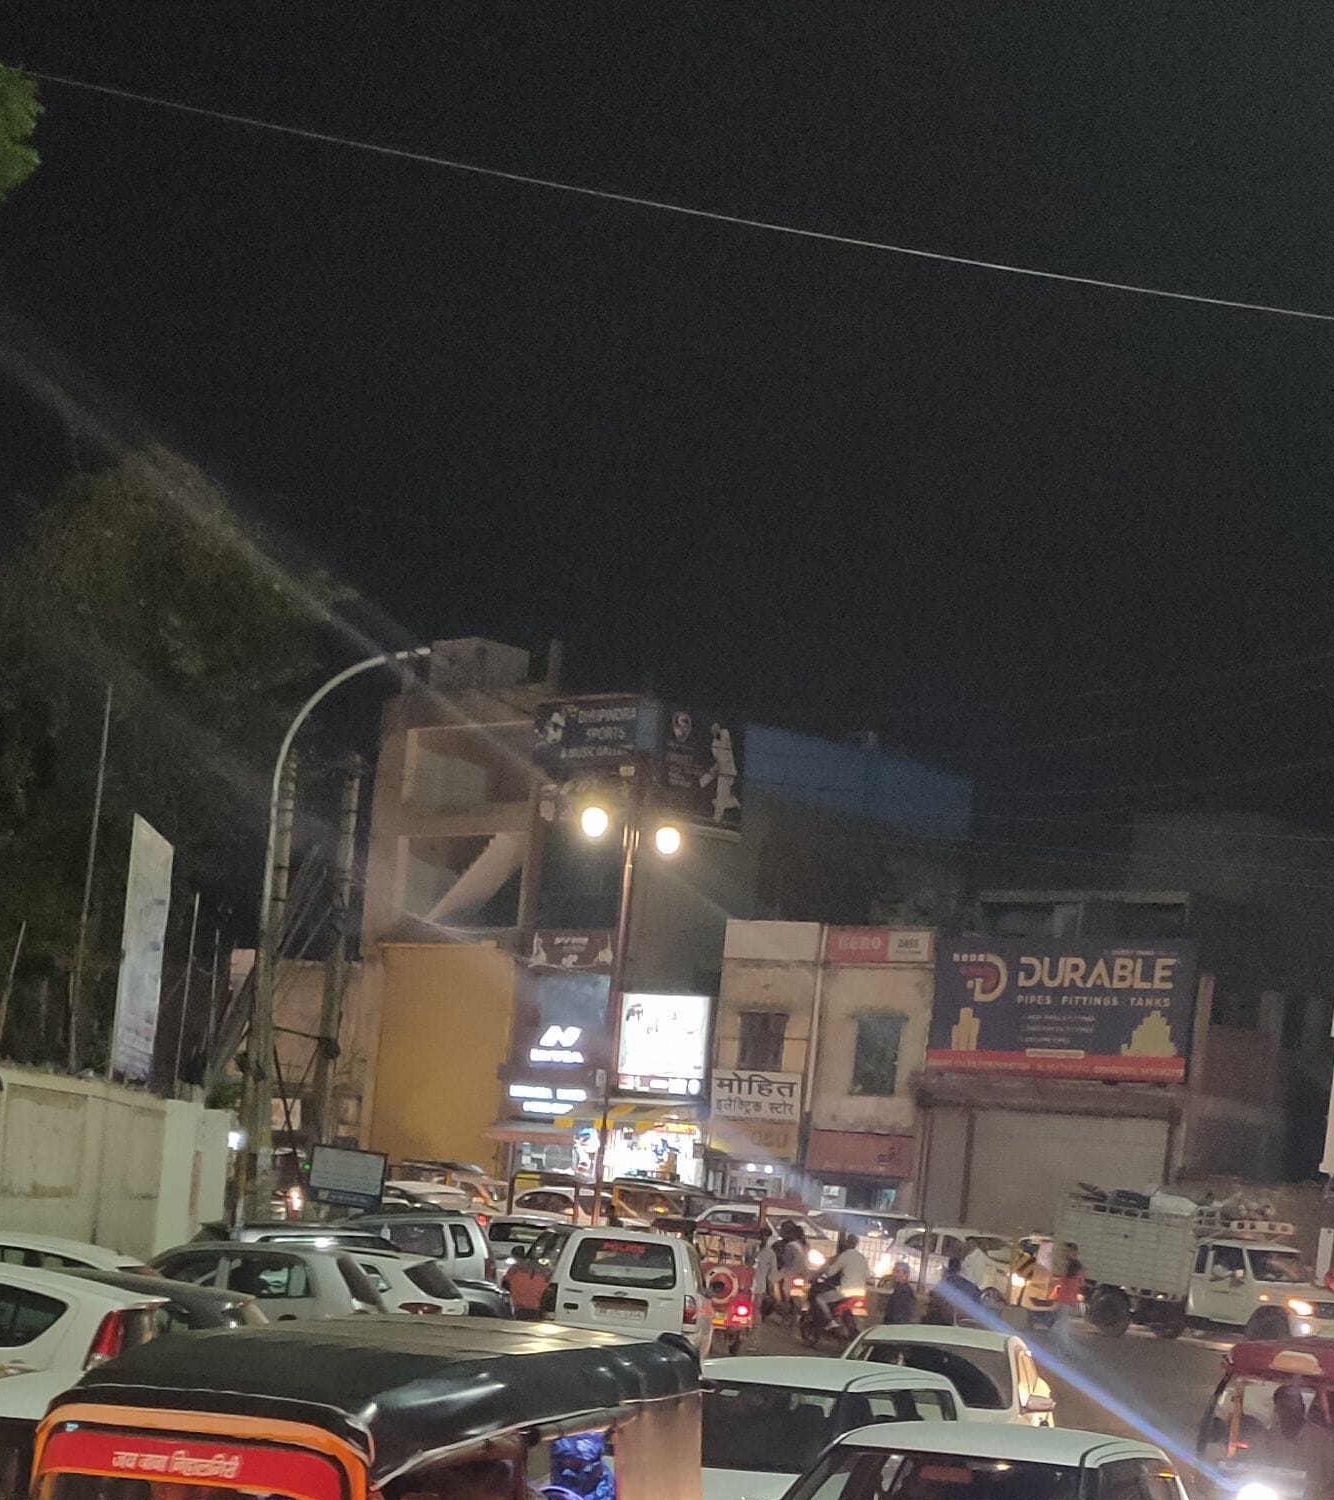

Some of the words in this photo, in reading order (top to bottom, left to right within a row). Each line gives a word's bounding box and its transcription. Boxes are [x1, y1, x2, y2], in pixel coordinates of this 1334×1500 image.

[1018, 955, 1177, 990] DURABLE
[1018, 994, 1052, 1006] PIPES
[1061, 994, 1119, 1007] FITTINGS
[1130, 996, 1171, 1008] TANKS
[714, 1072, 797, 1098] मोहित
[112, 1451, 139, 1469] जय
